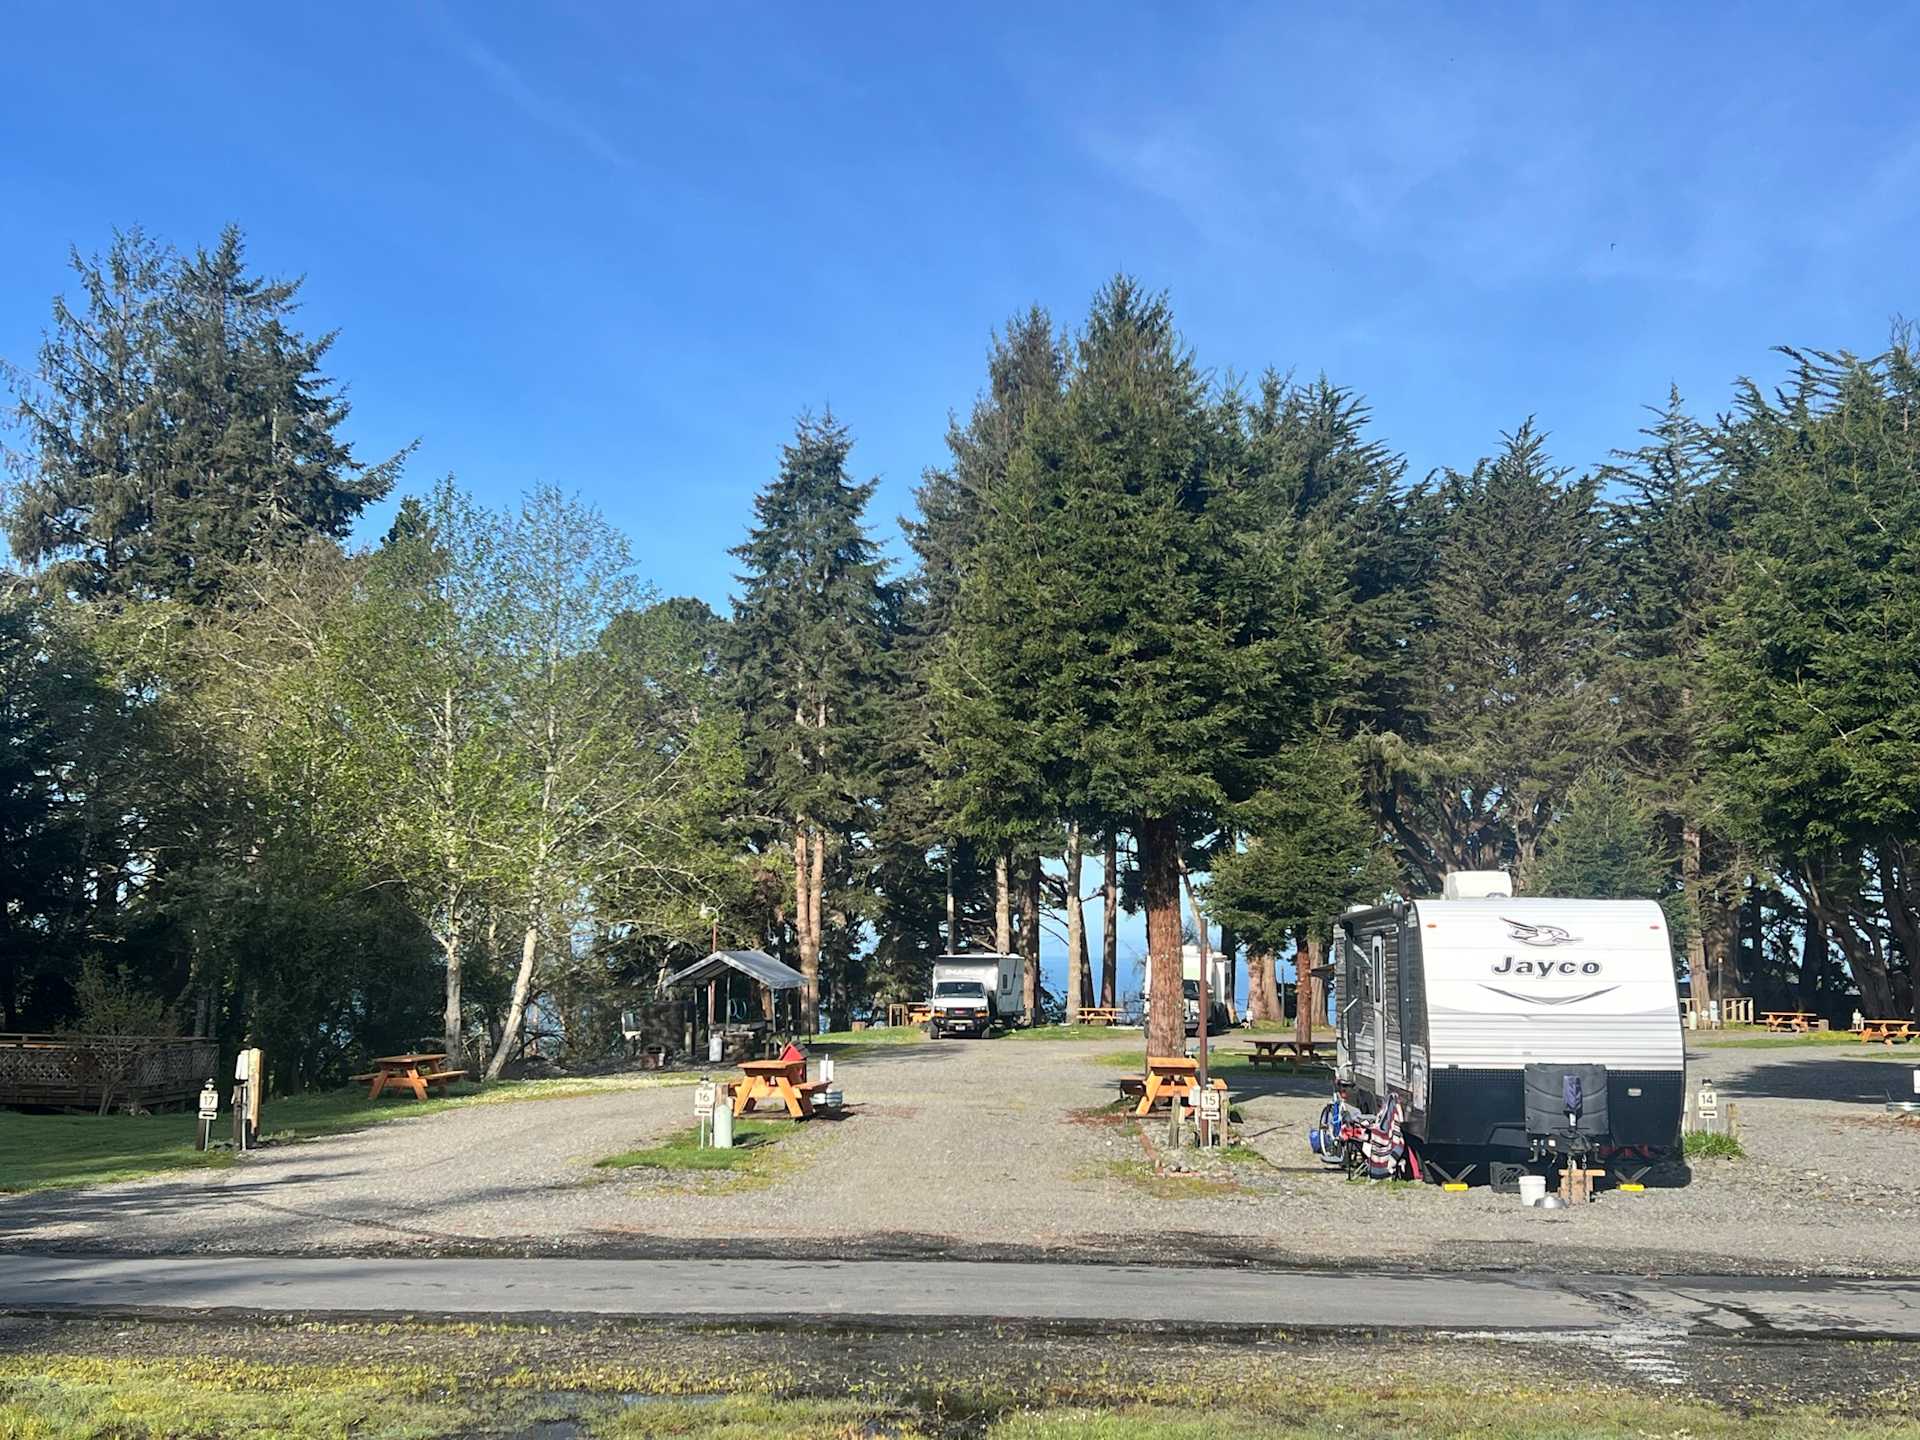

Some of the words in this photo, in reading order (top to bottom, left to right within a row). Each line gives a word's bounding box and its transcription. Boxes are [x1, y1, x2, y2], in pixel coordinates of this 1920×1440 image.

[1493, 956, 1601, 978] Jayco
[203, 1095, 214, 1106] 17
[698, 1092, 710, 1102] 16
[1205, 1095, 1216, 1106] 15
[1701, 1094, 1713, 1104] 14
